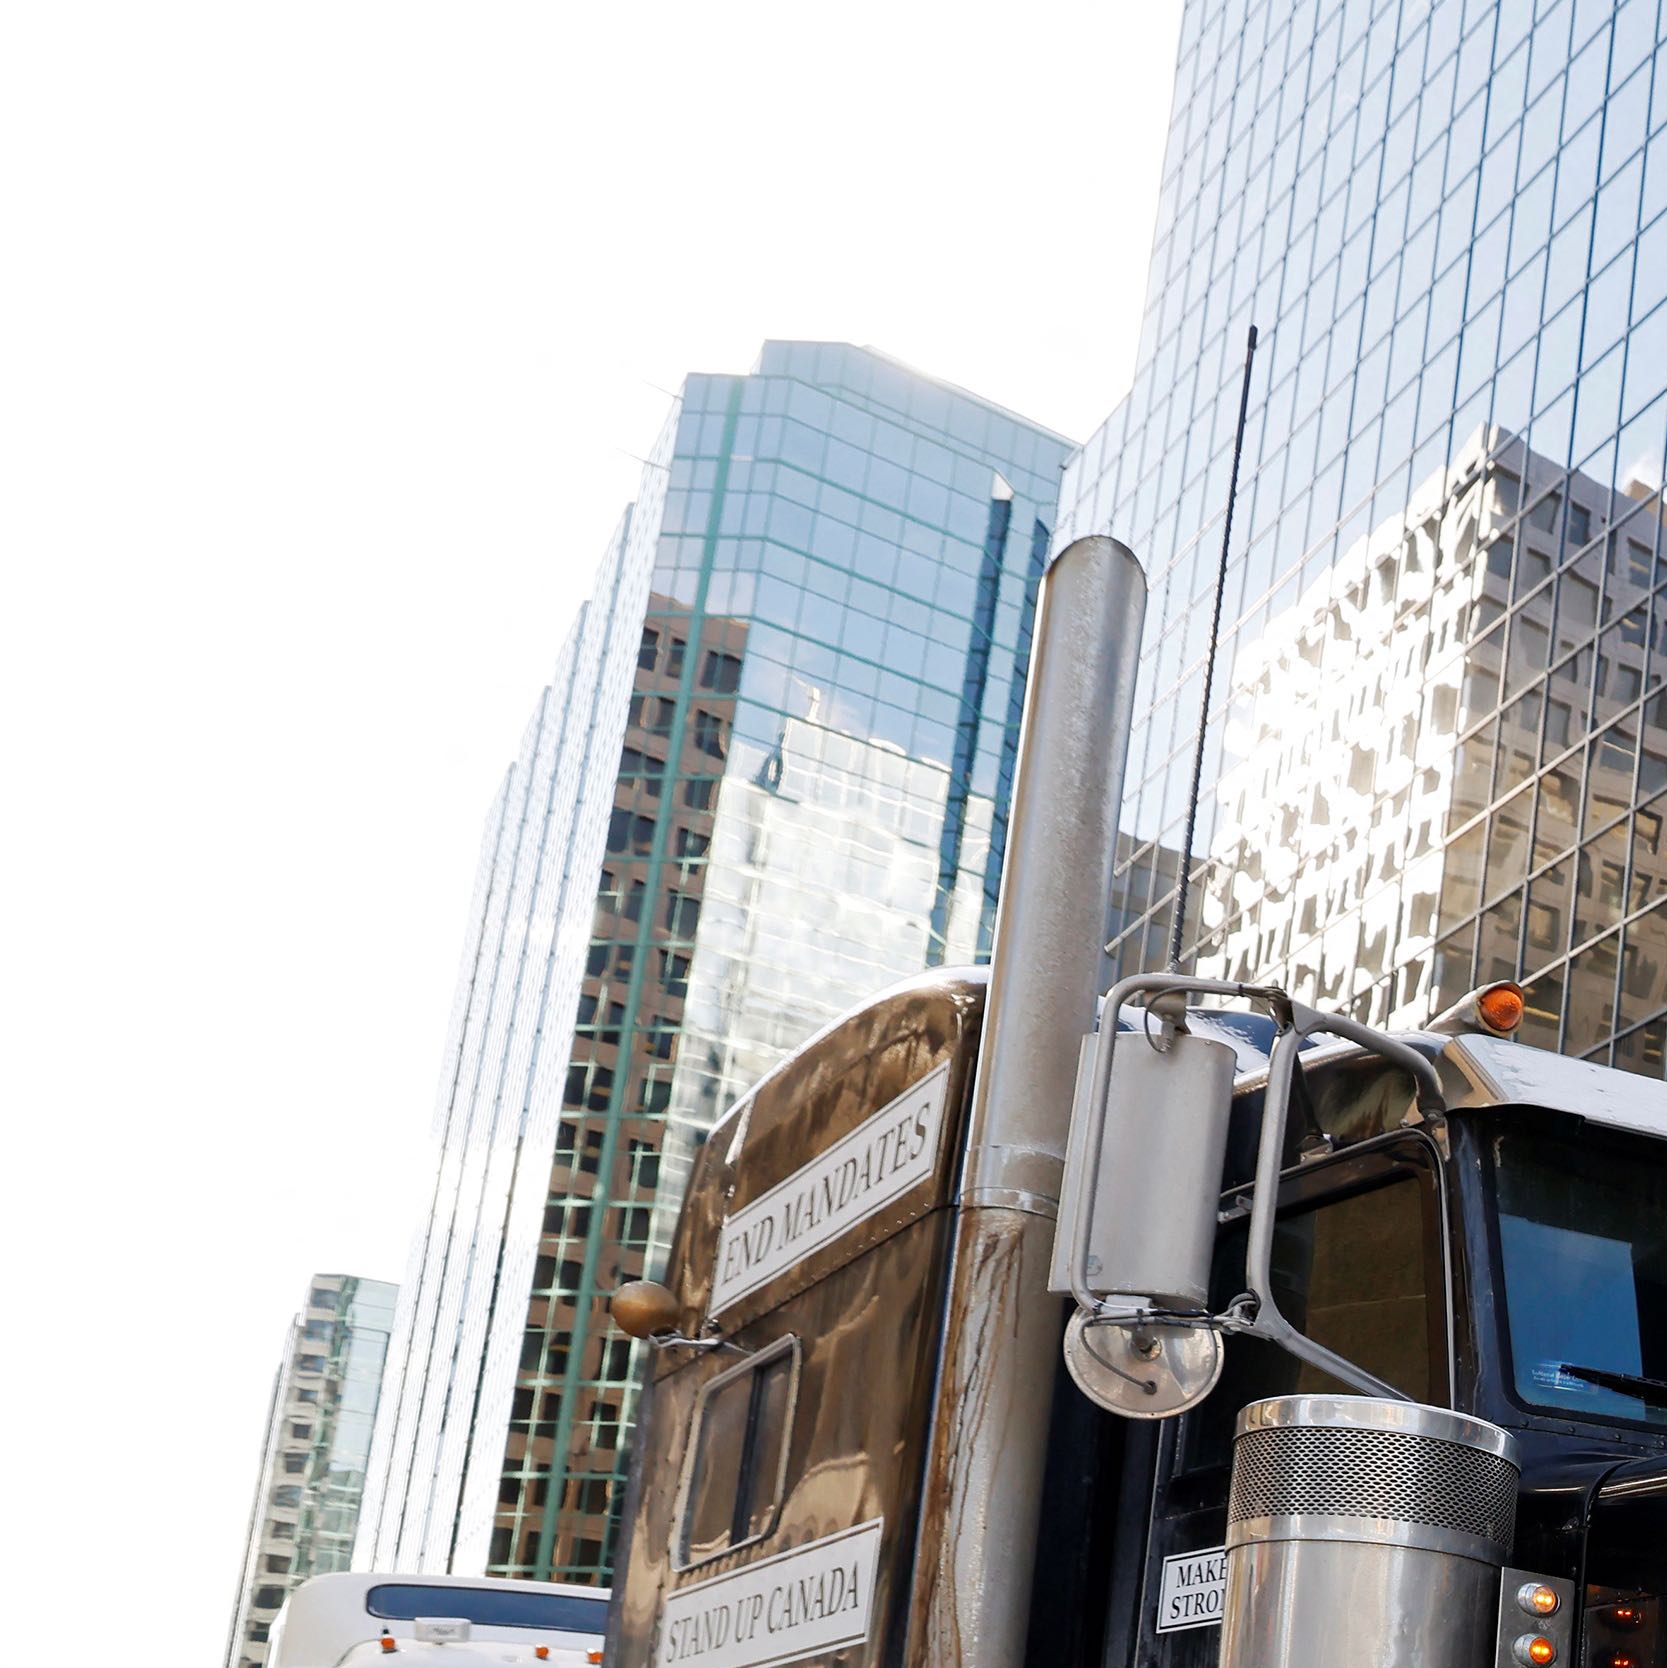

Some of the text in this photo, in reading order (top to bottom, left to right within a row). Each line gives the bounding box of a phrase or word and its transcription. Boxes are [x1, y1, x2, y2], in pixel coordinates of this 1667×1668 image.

[722, 1101, 932, 1284] END MANDATES
[666, 1565, 858, 1663] STAND UP CANADA
